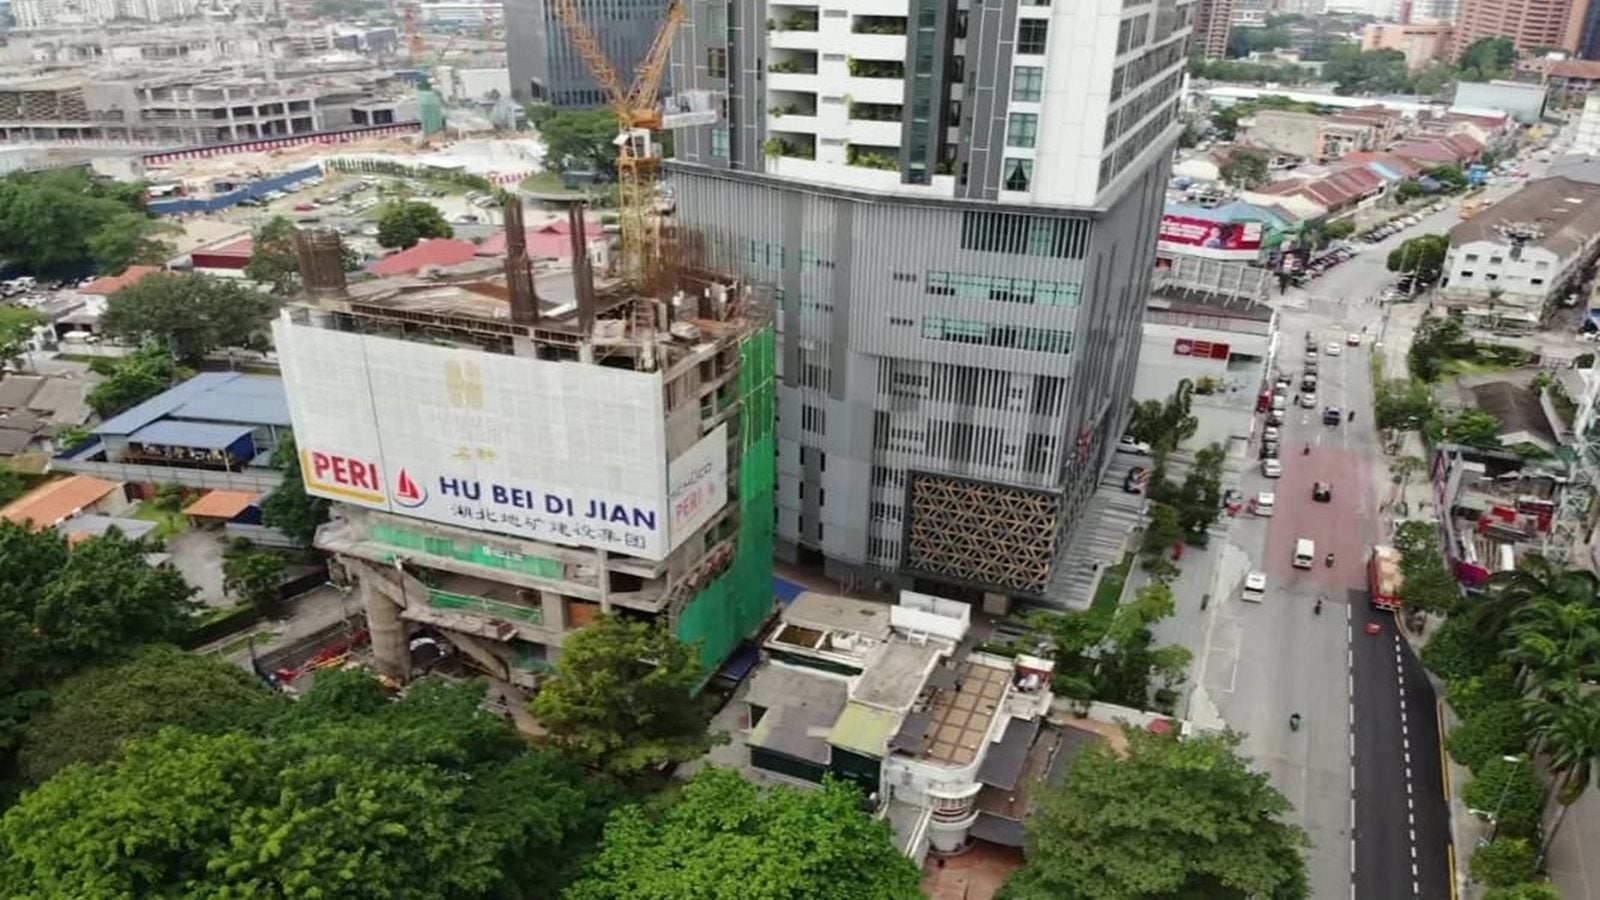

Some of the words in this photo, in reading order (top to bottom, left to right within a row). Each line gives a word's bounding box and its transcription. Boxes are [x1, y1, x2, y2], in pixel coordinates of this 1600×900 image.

[312, 451, 380, 491] PERI
[439, 476, 481, 500] HU
[492, 484, 534, 510] BEI
[545, 494, 574, 517] DI
[585, 499, 656, 530] JIAN
